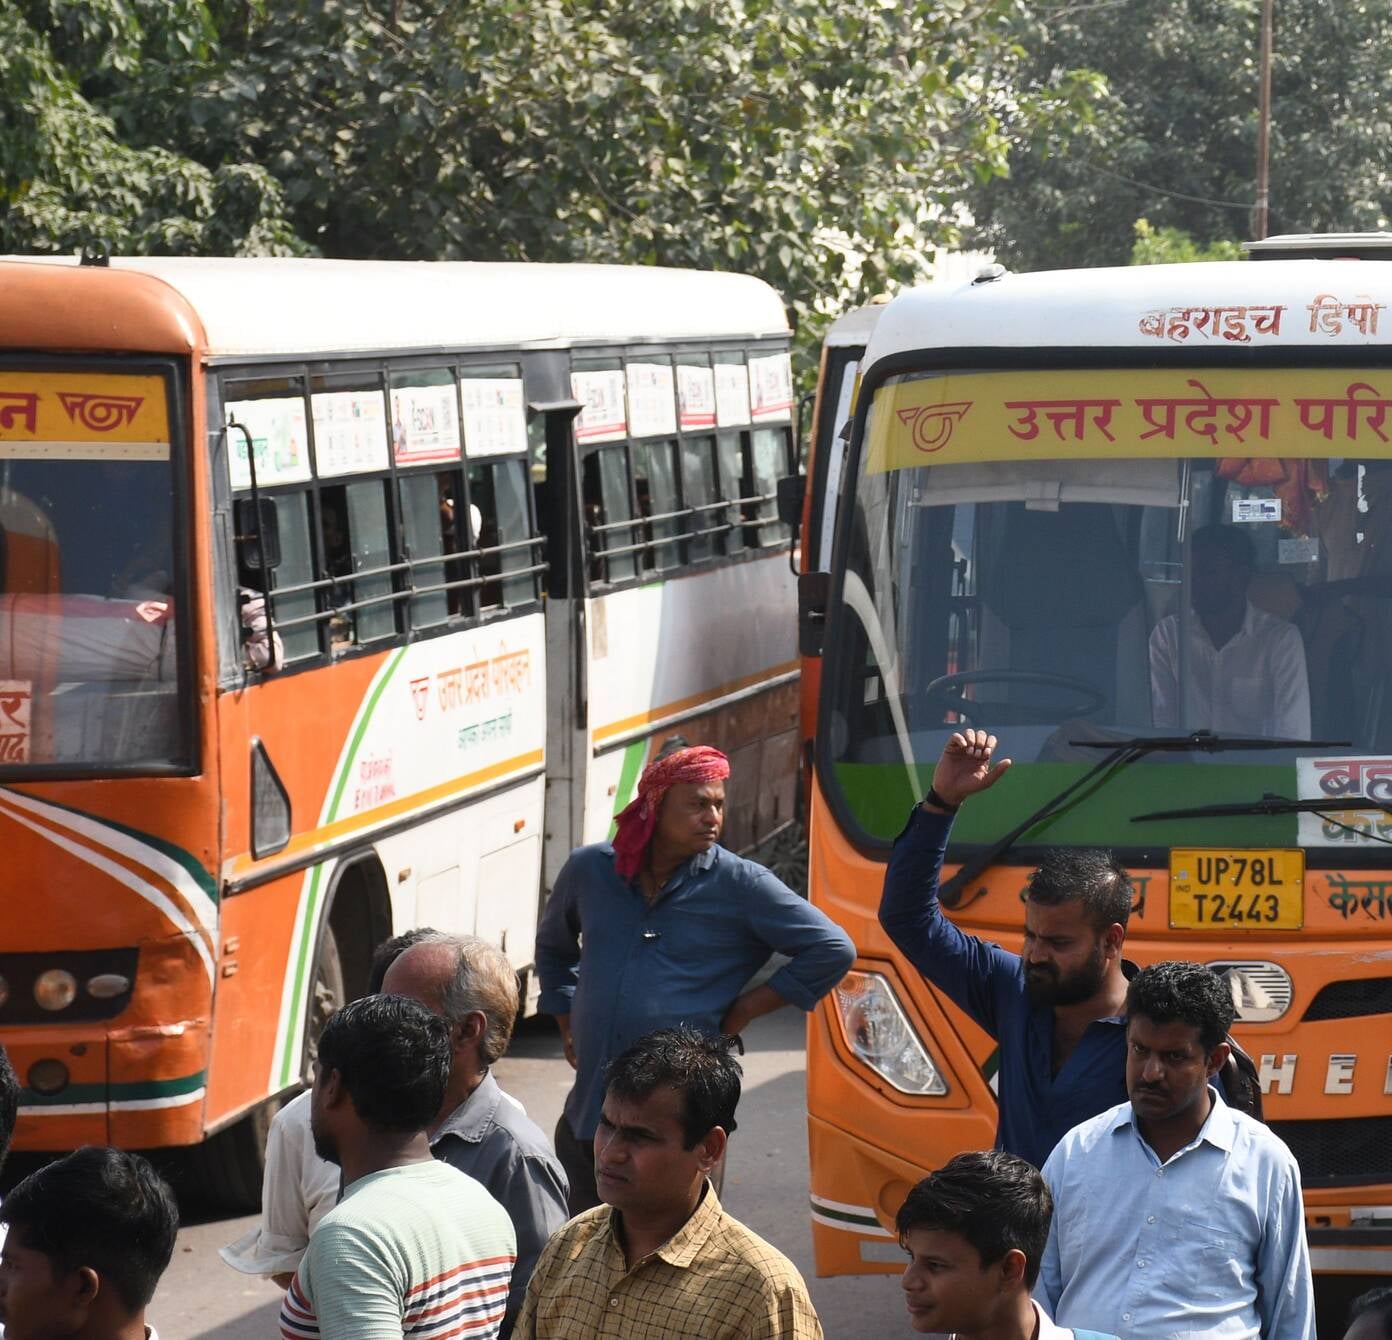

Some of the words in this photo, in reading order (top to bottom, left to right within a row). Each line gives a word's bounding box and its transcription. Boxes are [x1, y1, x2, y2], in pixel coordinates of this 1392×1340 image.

[1138, 304, 1288, 344] बहराइच
[1004, 399, 1122, 442] उत्तर
[1135, 379, 1281, 445] प्रदेश
[1197, 857, 1283, 886] UP78L
[1193, 894, 1280, 923] T2443
